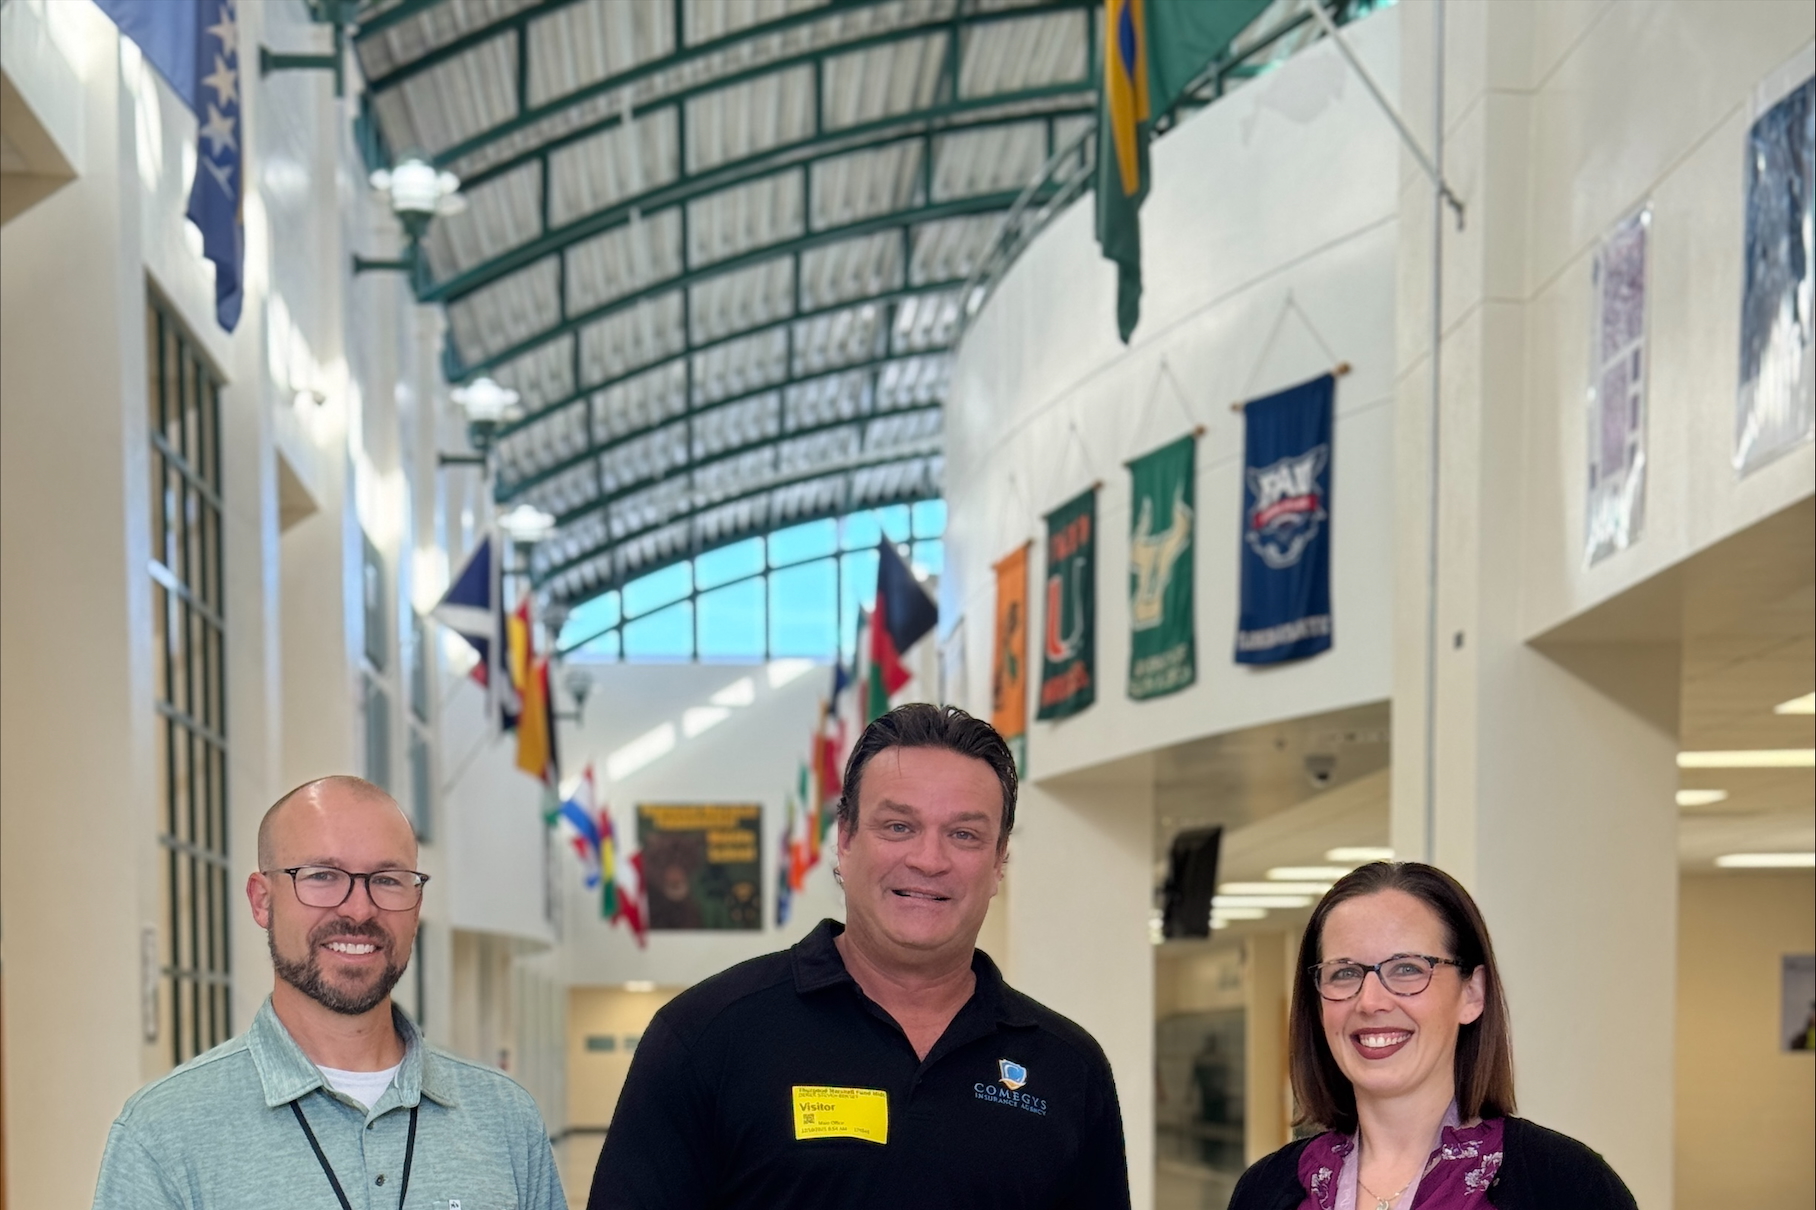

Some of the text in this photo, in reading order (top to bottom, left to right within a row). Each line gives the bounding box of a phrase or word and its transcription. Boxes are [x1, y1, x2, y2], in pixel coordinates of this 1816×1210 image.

[974, 1082, 1047, 1110] COMEGYS
[975, 1092, 1018, 1107] INSURANCE
[799, 1102, 836, 1112] Visitor
